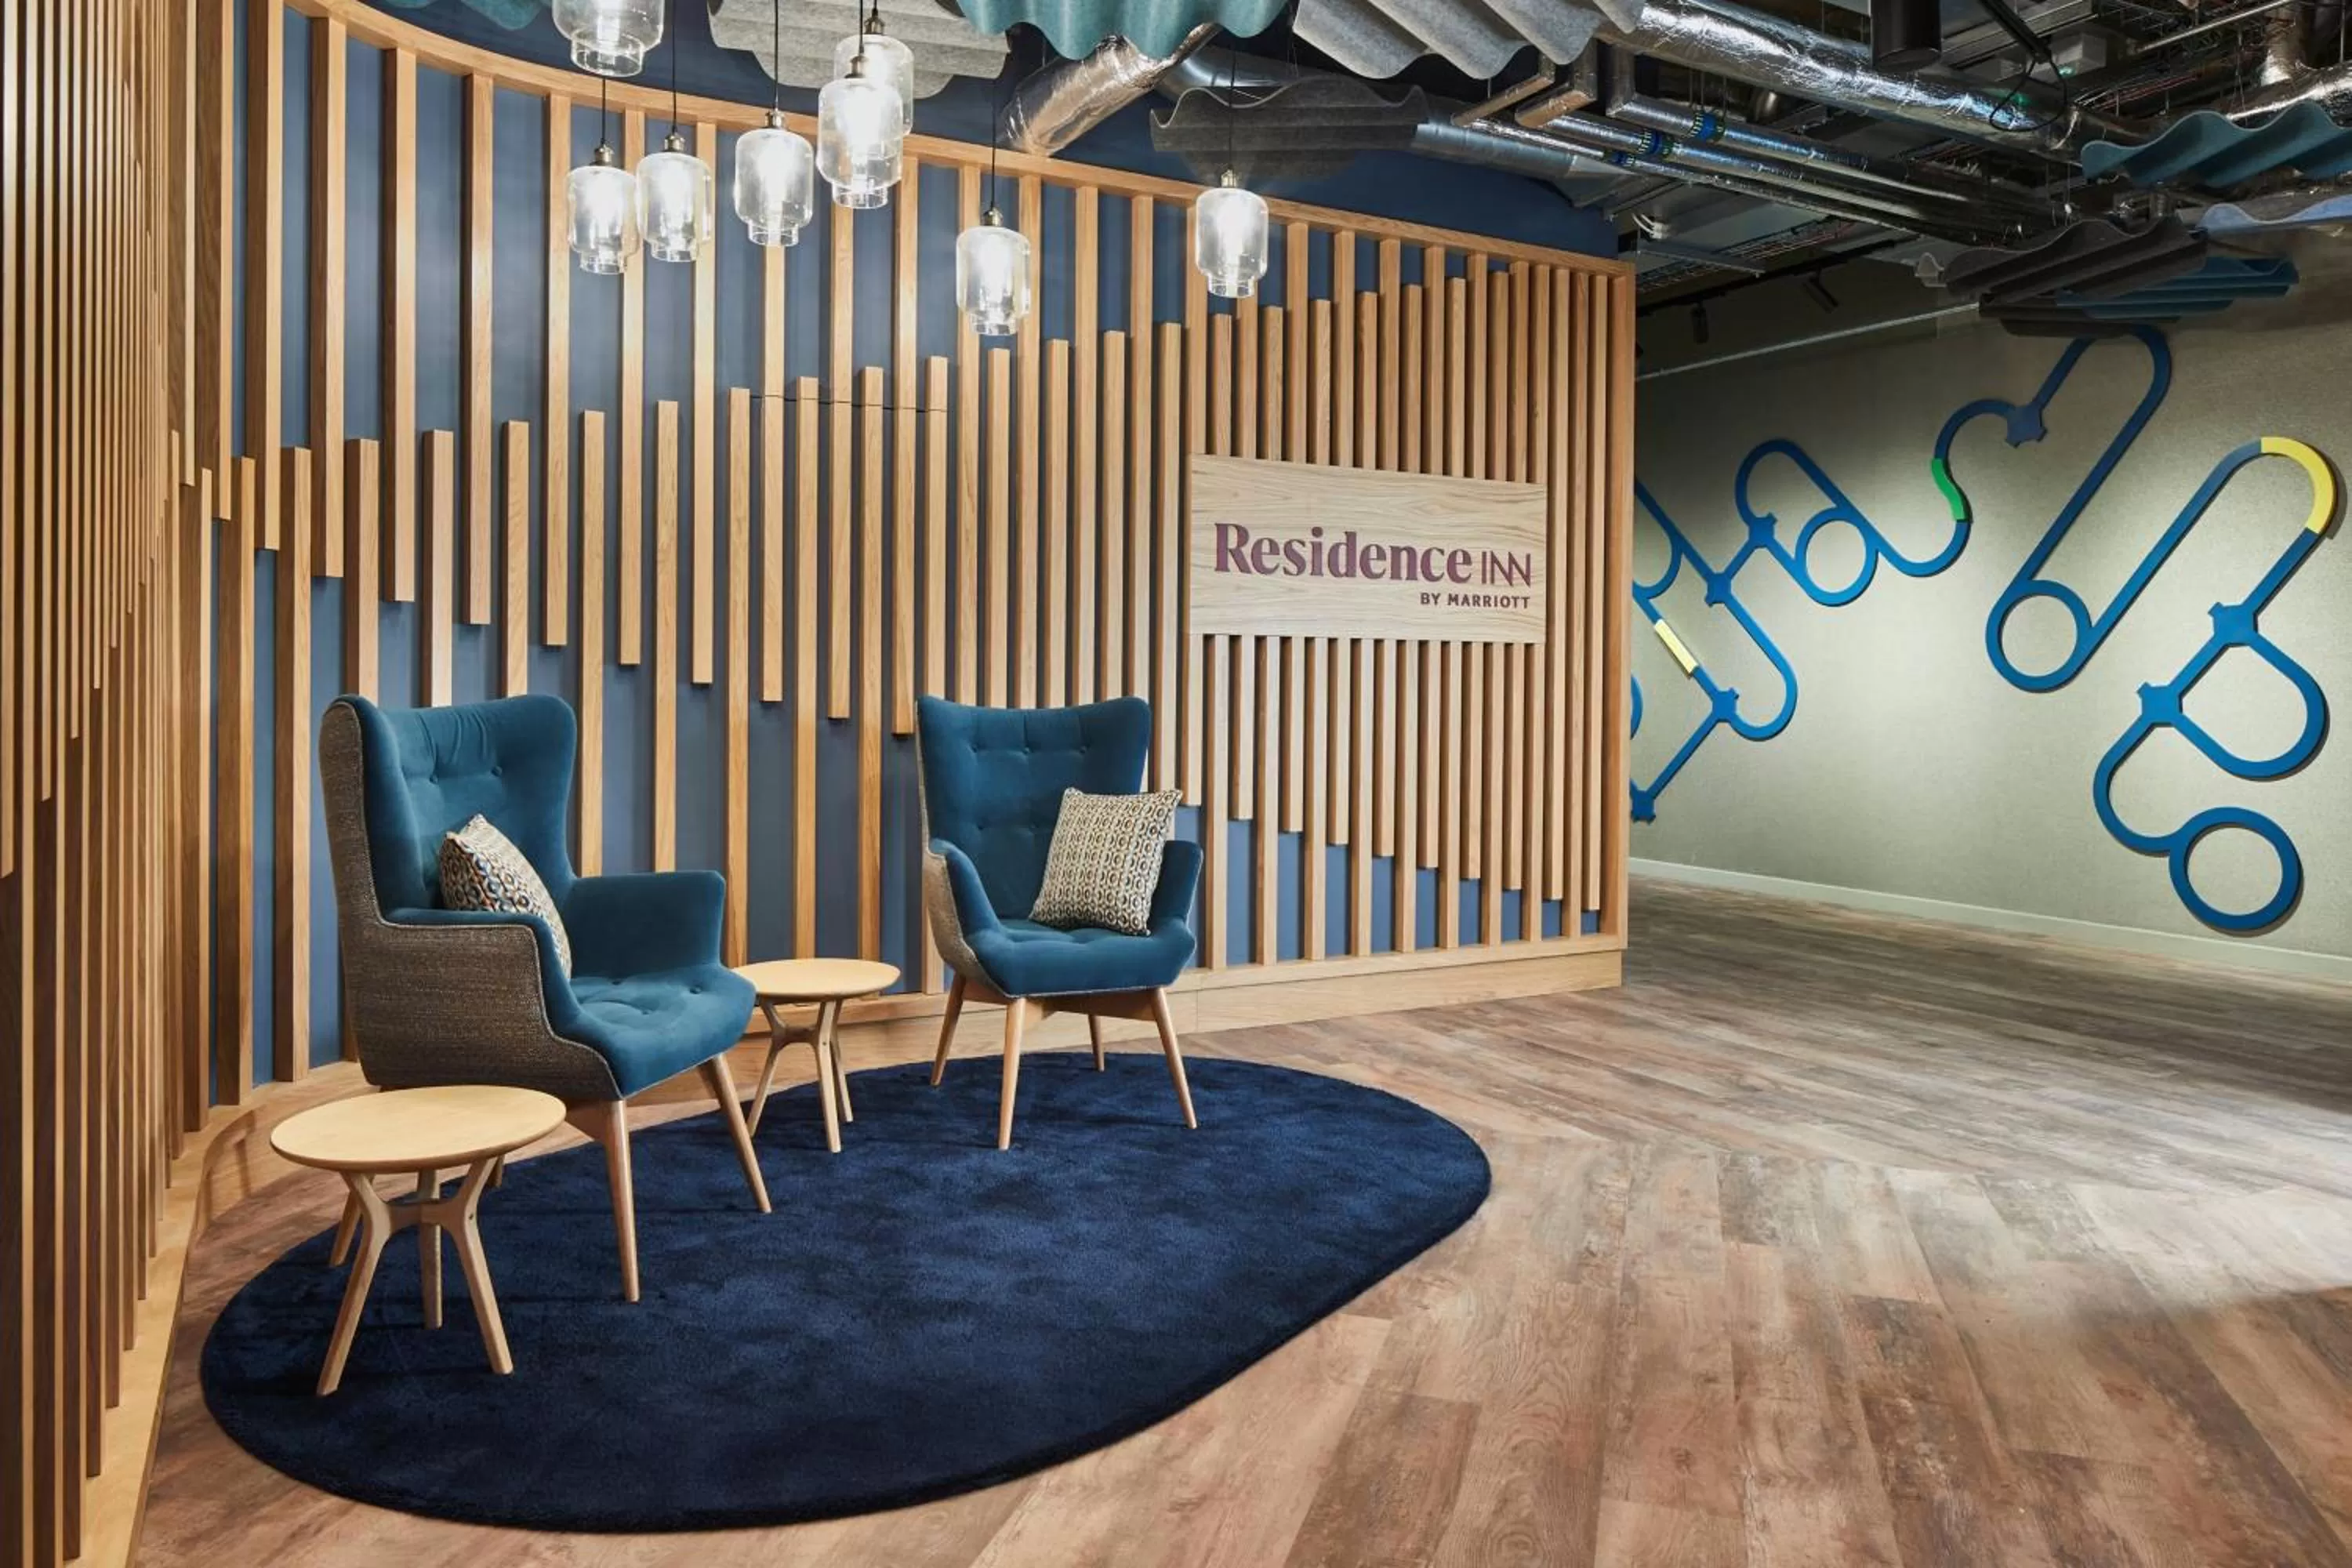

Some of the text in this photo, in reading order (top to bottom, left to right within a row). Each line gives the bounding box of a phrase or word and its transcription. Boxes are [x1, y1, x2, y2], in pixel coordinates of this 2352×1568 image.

[1214, 522, 1532, 588] Residence INN
[1420, 592, 1531, 609] BY MARRIOTT
